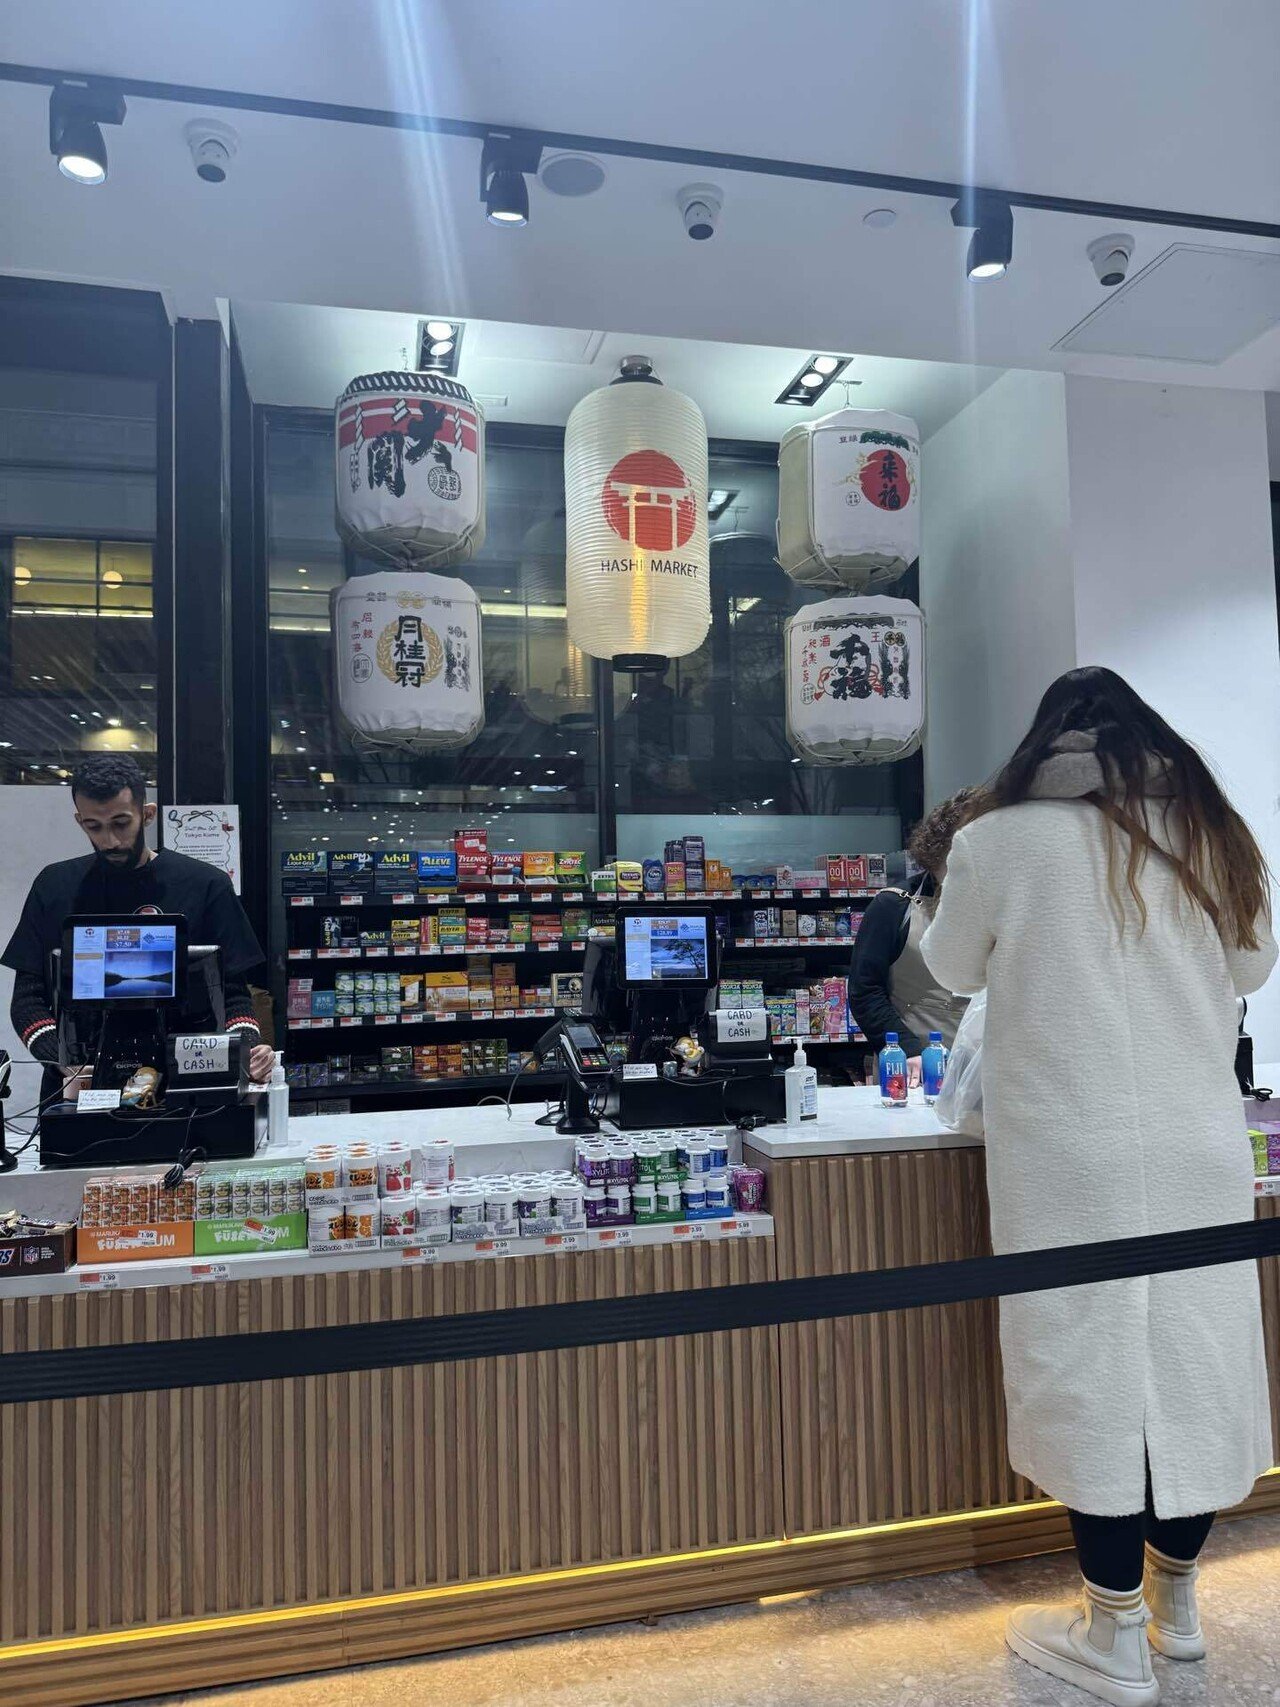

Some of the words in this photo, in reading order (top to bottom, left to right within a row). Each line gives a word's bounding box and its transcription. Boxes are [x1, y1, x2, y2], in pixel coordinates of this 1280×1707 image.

[601, 559, 643, 572] HASHI
[651, 560, 698, 578] MARKET
[394, 615, 426, 688] 月桂冠
[287, 852, 315, 862] Advil
[332, 854, 353, 863] Advil
[353, 853, 366, 862] PM
[381, 854, 410, 863] Advil
[458, 855, 488, 863] TYLENOL
[492, 855, 522, 863] TYLENOL
[365, 932, 385, 940] Advil
[727, 1010, 753, 1020] CARD
[728, 1027, 751, 1038] CASH
[183, 1037, 218, 1050] CARD
[184, 1059, 215, 1071] CASH
[886, 1061, 903, 1075] FIJI
